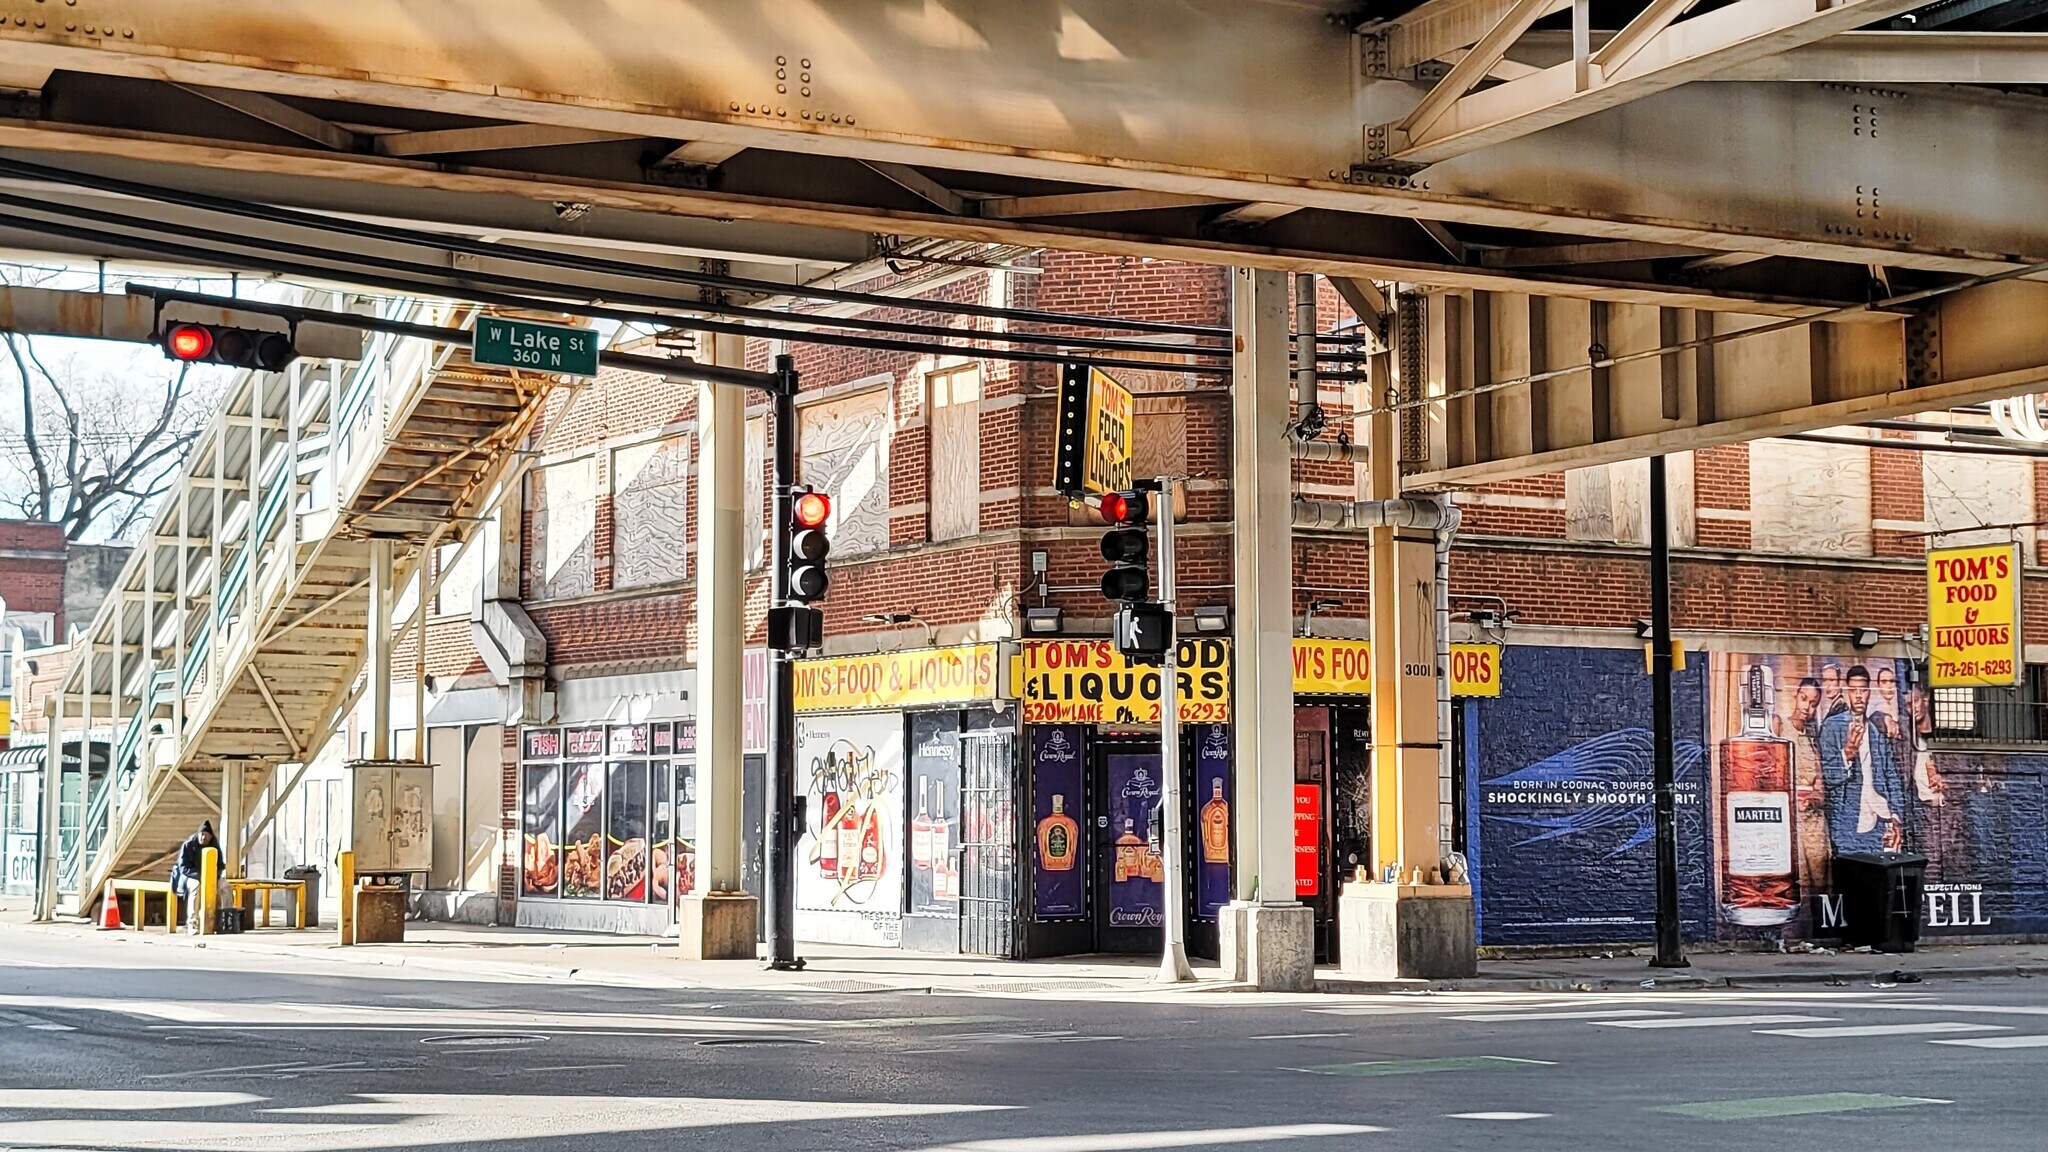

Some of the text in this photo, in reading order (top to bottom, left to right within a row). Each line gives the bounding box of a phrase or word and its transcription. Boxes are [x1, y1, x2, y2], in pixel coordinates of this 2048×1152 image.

[490, 327, 584, 352] W Lake St
[513, 349, 561, 366] 360 N
[1101, 380, 1126, 419] TOM'S
[1099, 409, 1125, 458] FOOD
[1108, 442, 1115, 462] &
[1090, 435, 1131, 493] LIQUORS
[1935, 555, 2009, 583] TOM'S
[1946, 584, 1998, 604] FOOD
[1965, 607, 1979, 624] &
[1936, 627, 2009, 651] LIQUORS
[1025, 640, 1226, 669] TOM'S OD
[837, 662, 883, 695] FOOD
[889, 660, 904, 691] &
[909, 652, 991, 694] LIQUORS
[1405, 664, 1431, 677] 3001
[1450, 650, 1491, 684] ORS
[1936, 659, 2012, 678] 773-261-6293
[531, 733, 559, 756] FISH
[918, 743, 955, 760] Hennessy
[1040, 750, 1057, 762] Crown
[1121, 787, 1140, 798] Crown
[1513, 780, 1543, 789] BORN
[1547, 781, 1559, 789] IN
[1296, 796, 1311, 804] YOU
[1488, 792, 1581, 804] SHOCKINGLY
[1587, 793, 1646, 804] SMOOTH
[1736, 810, 1781, 820] MARTELL
[1924, 883, 1983, 891] EXPECTATIONS
[1109, 906, 1141, 925] Crown
